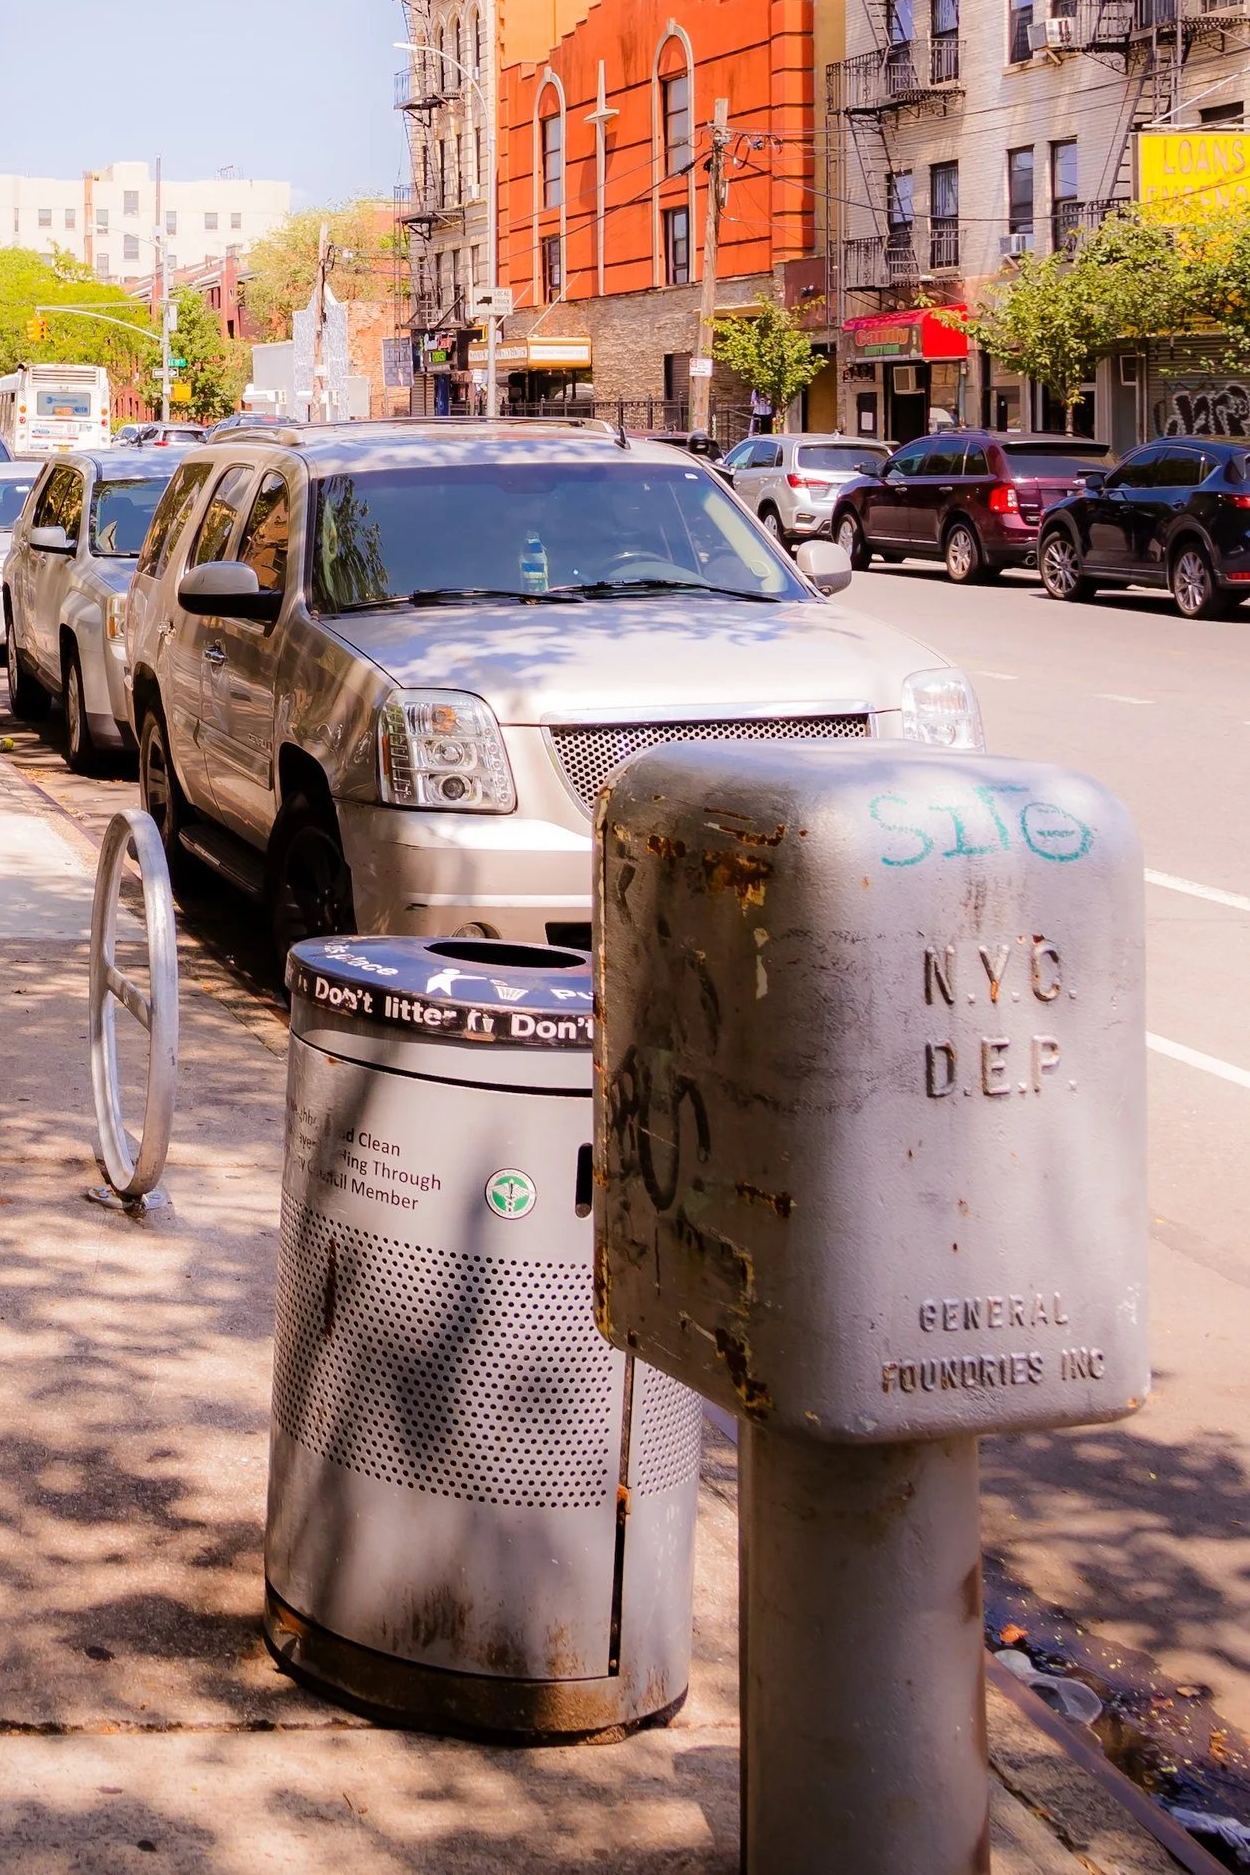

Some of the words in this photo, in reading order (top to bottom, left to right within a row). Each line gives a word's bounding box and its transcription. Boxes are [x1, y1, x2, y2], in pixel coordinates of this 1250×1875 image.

[1163, 138, 1245, 175] LOANS
[314, 976, 373, 1014] Don't
[384, 995, 457, 1026] litter
[550, 988, 594, 1000] Pu
[358, 1132, 401, 1157] Clean
[351, 1177, 418, 1210] Member
[372, 1160, 442, 1192] Through
[919, 1291, 1069, 1332] GENERAL
[881, 1350, 1044, 1394] FOUNDRIES
[1060, 1346, 1106, 1381] INC
